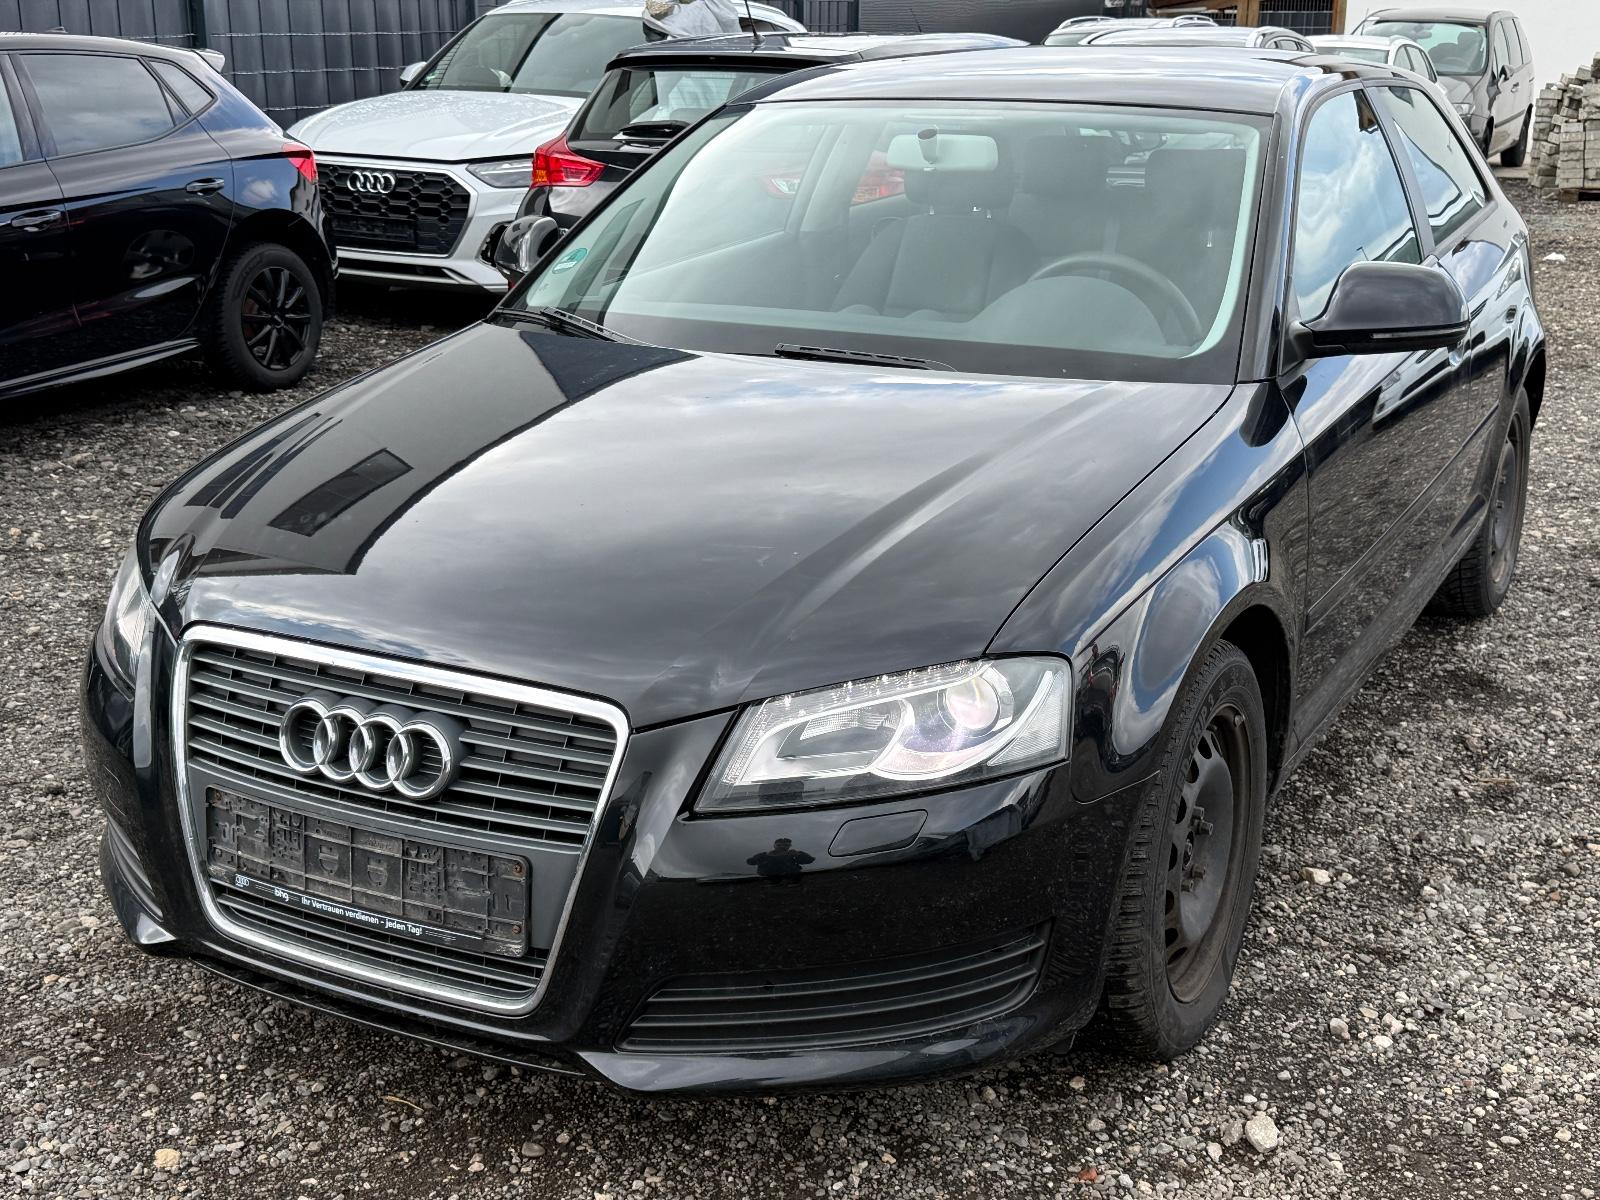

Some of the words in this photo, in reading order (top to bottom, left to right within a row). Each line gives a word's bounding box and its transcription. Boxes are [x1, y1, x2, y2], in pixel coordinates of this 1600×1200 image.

[274, 887, 289, 902] bhg
[301, 896, 311, 906] Ihr
[311, 899, 344, 915] Vertrauen
[345, 909, 379, 925] verdienen
[385, 918, 406, 931] jeden
[406, 924, 423, 936] Tag!
